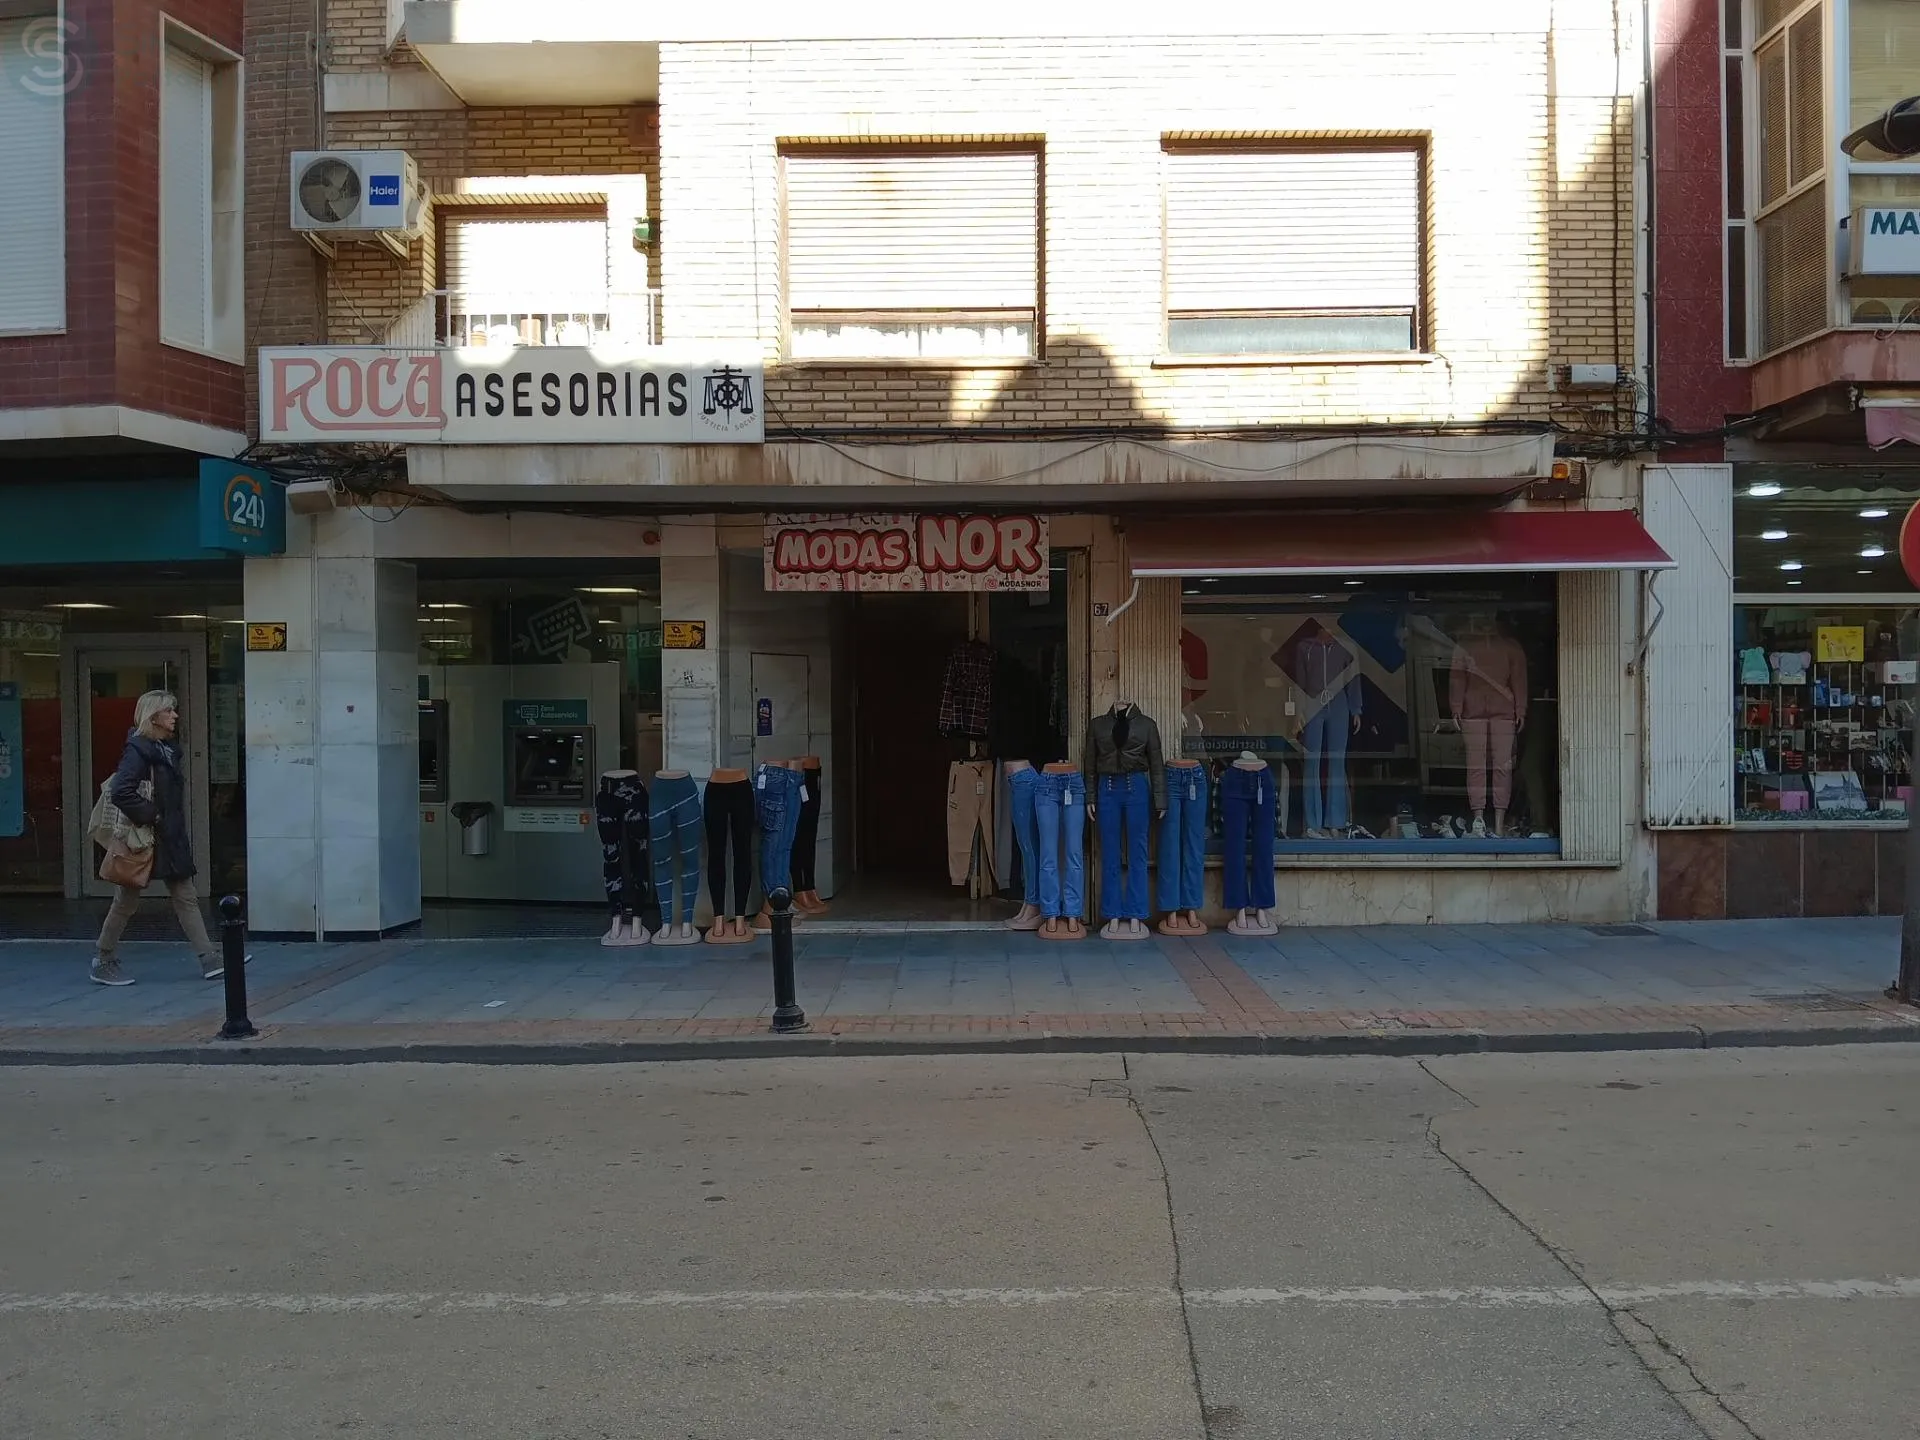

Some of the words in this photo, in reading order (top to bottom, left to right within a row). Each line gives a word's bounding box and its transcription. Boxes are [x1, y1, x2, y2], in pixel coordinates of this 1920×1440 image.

[370, 186, 398, 195] Haier
[1870, 211, 1920, 235] MA
[270, 356, 447, 431] ROCA
[456, 372, 687, 417] ASESORIAS
[697, 411, 729, 432] JUSTICIA
[776, 532, 908, 570] MODAS
[920, 516, 1040, 571] NOR
[1094, 604, 1108, 616] 67
